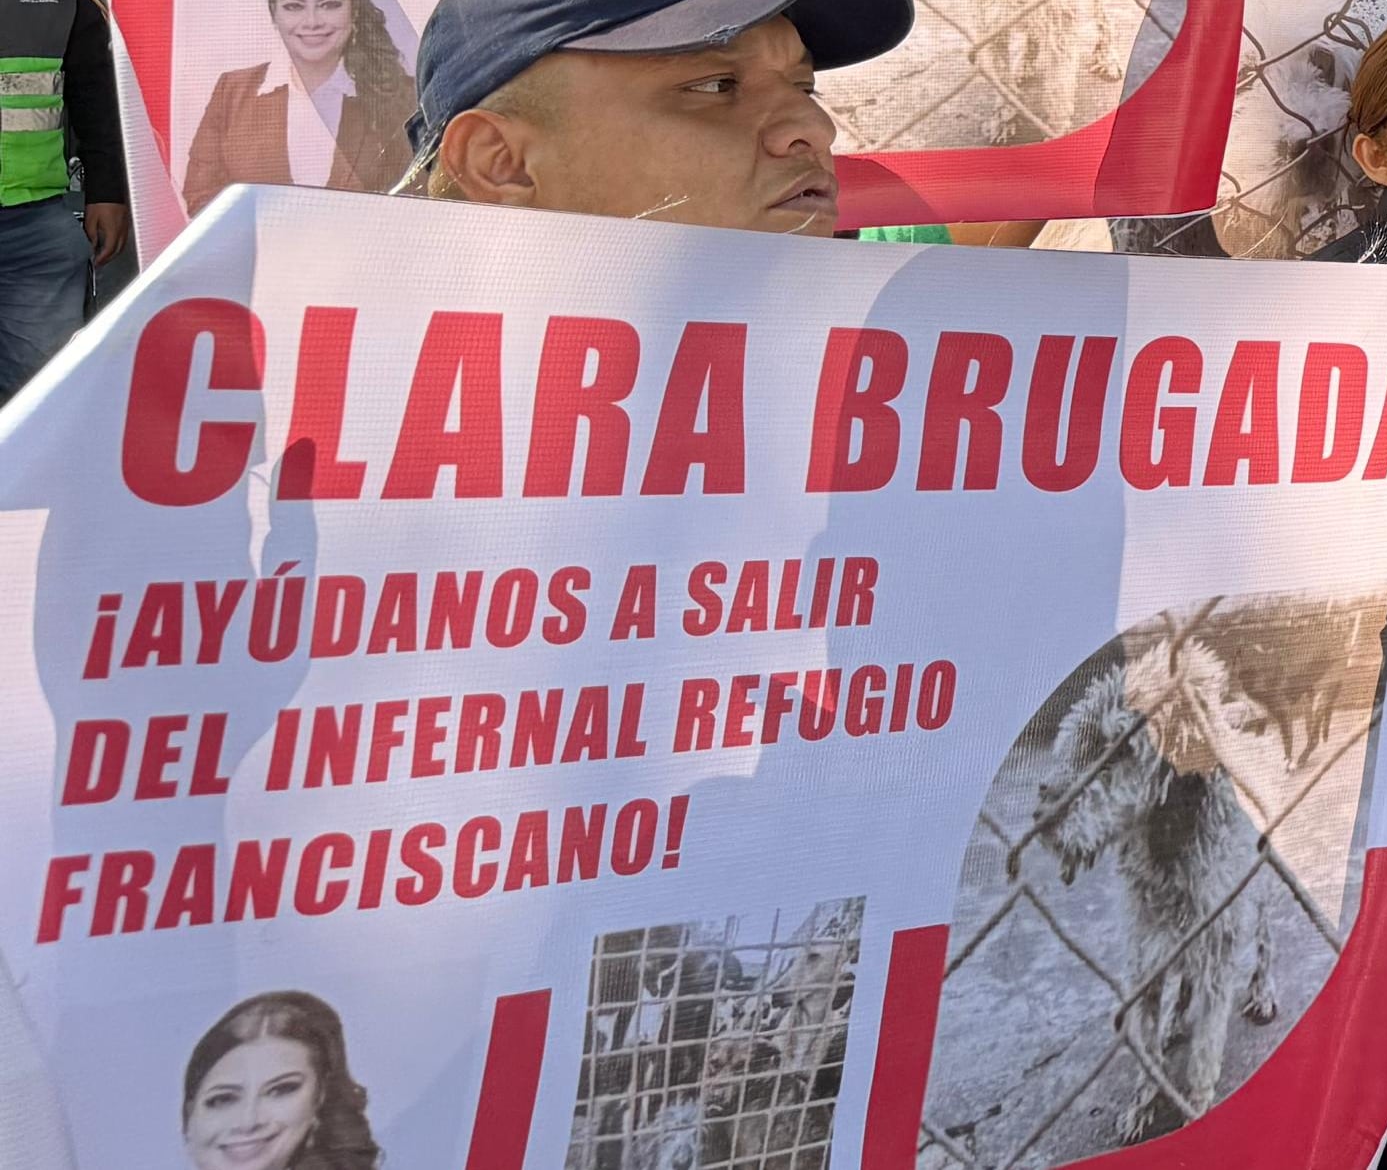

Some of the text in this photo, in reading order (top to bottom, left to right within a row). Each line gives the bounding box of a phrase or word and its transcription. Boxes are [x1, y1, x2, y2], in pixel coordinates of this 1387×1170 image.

[121, 296, 748, 507] CLARA
[82, 556, 879, 680] ¡AYÚDANOS A SALIR
[60, 659, 957, 806] DEL INFERNAL REFUGIO
[36, 794, 691, 945] FRANCISCANO!
